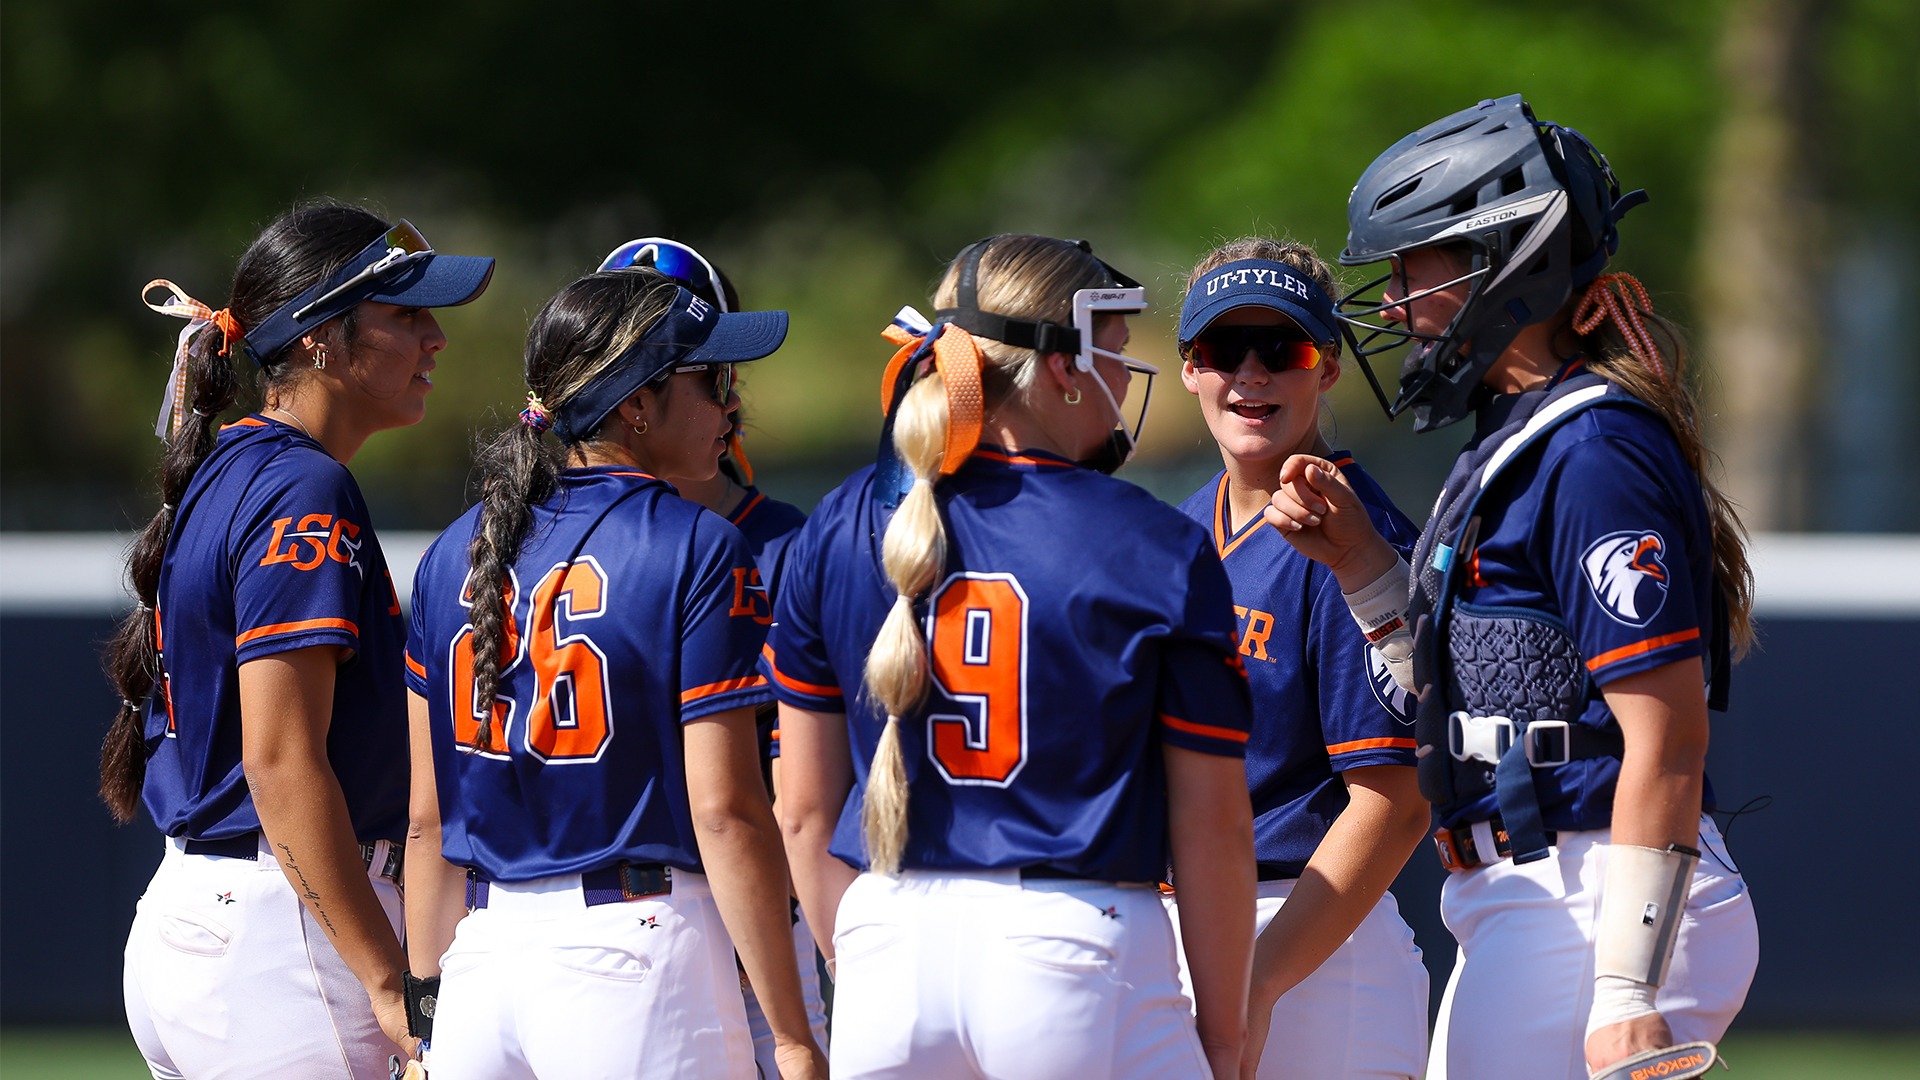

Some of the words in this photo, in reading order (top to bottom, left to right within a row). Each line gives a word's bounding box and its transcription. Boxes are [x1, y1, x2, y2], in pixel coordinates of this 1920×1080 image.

[1466, 210, 1518, 229] EASTON
[259, 513, 361, 571] LSC
[449, 554, 615, 765] 26
[927, 571, 1029, 788] 9
[1630, 1053, 1705, 1080] NOKONA
